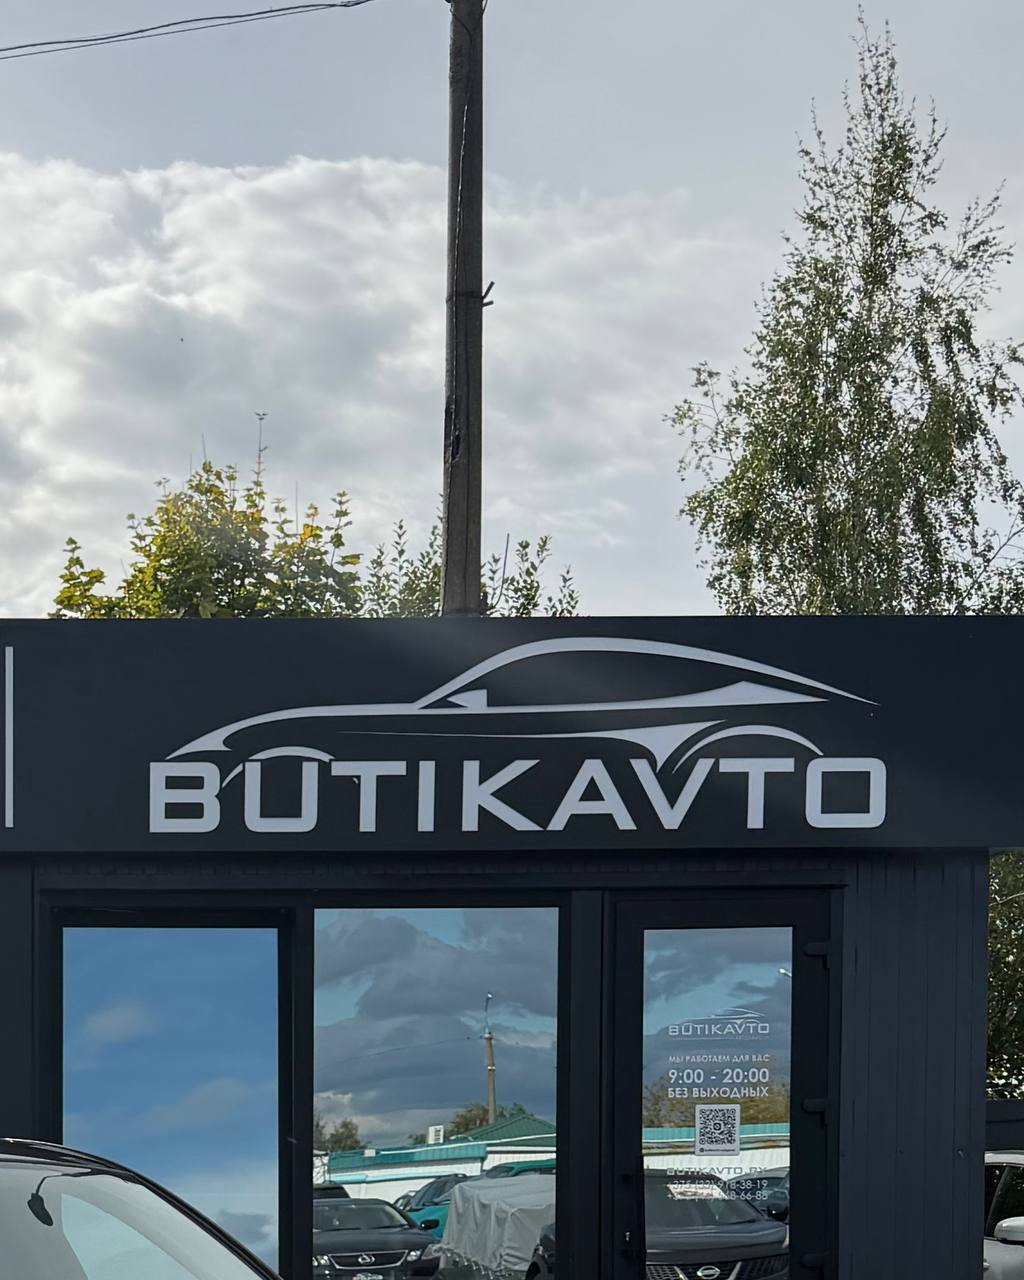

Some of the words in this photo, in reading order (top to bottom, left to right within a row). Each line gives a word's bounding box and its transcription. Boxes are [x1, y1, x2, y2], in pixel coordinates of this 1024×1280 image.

[149, 757, 887, 833] BUTIKAVTO
[668, 1023, 770, 1036] BUTIKAVTO
[668, 1056, 684, 1064] МЫ
[685, 1055, 730, 1063] РАБОТАЕМ
[752, 1054, 770, 1062] ВАС
[668, 1069, 704, 1084] 9:00
[722, 1068, 769, 1083] 20:00
[667, 1088, 688, 1098] БЕЗ
[692, 1087, 769, 1098] ВЫХОДНЫХ
